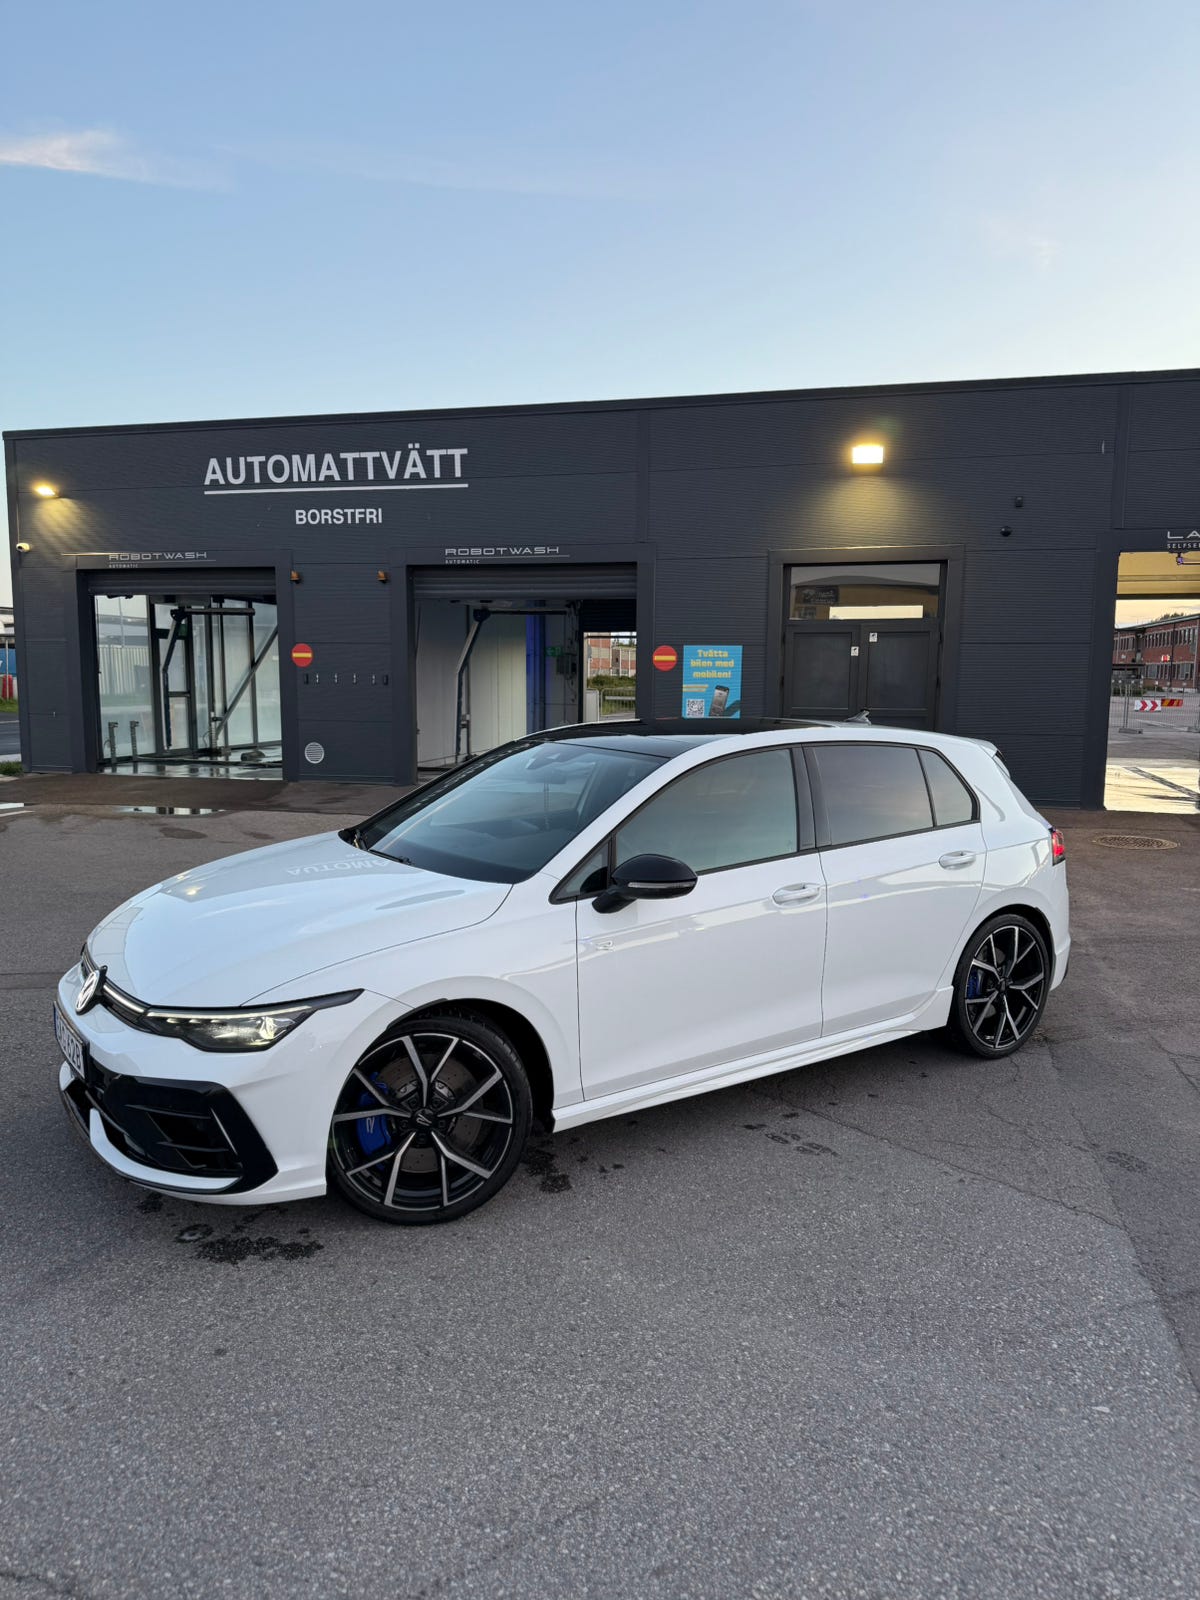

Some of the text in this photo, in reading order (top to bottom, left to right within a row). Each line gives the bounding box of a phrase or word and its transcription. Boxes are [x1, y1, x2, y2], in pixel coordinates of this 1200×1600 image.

[204, 443, 468, 485] AUTOMATTVÄTT
[295, 508, 383, 524] BORSTFRI
[445, 546, 560, 556] ROBOTWASH
[108, 552, 208, 561] ROBOTWASH
[697, 649, 729, 658] Tvätta
[690, 659, 735, 668] bilen med
